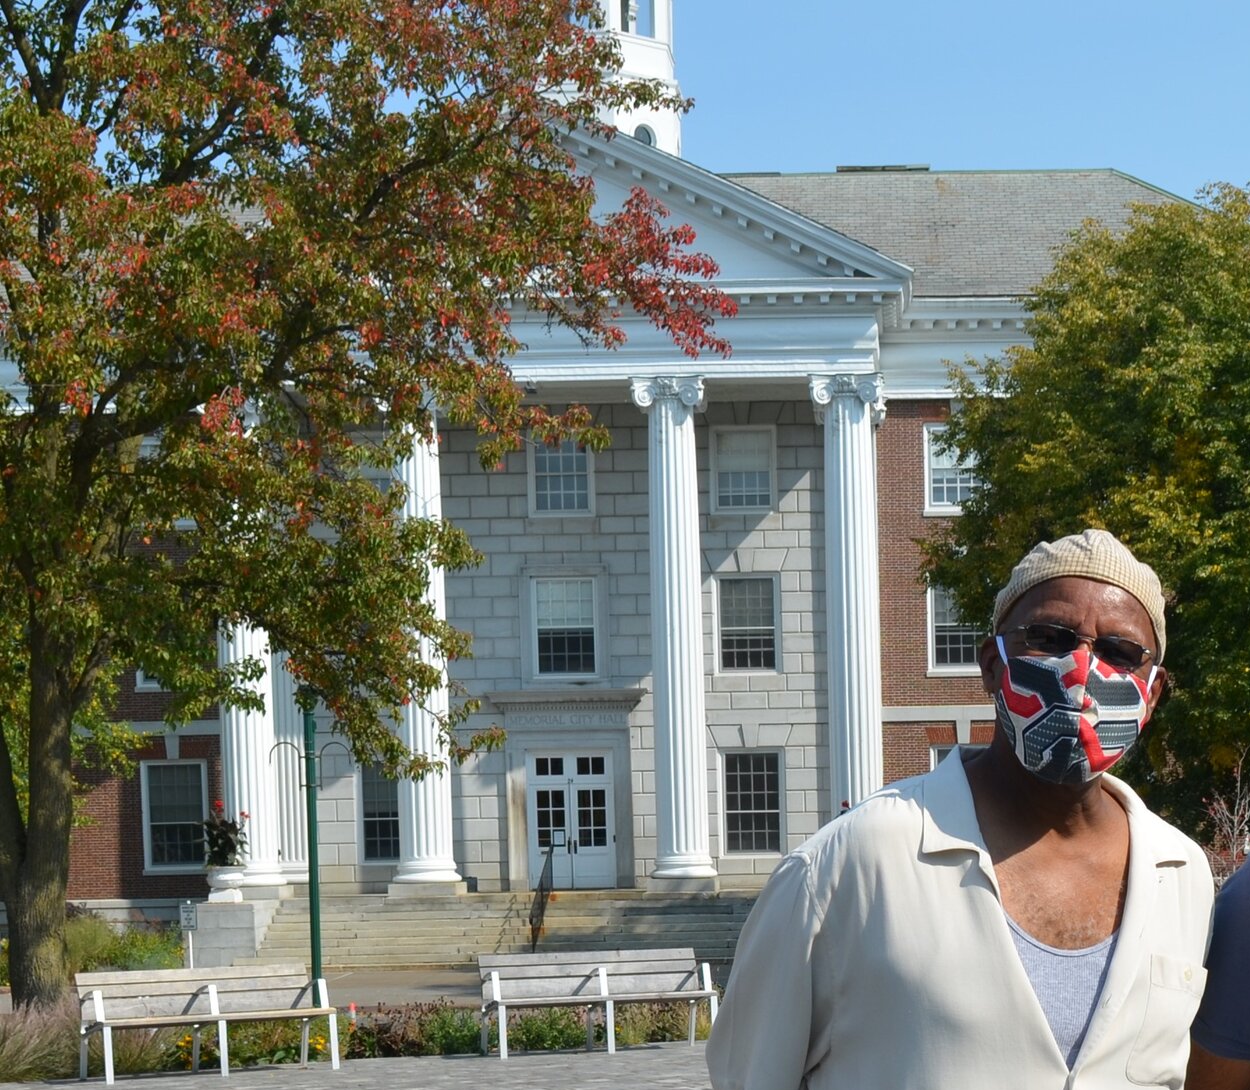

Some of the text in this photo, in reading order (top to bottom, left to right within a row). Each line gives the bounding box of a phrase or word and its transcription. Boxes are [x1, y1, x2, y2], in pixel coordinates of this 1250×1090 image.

[511, 713, 627, 725] MEMORIAL CITY HALL
